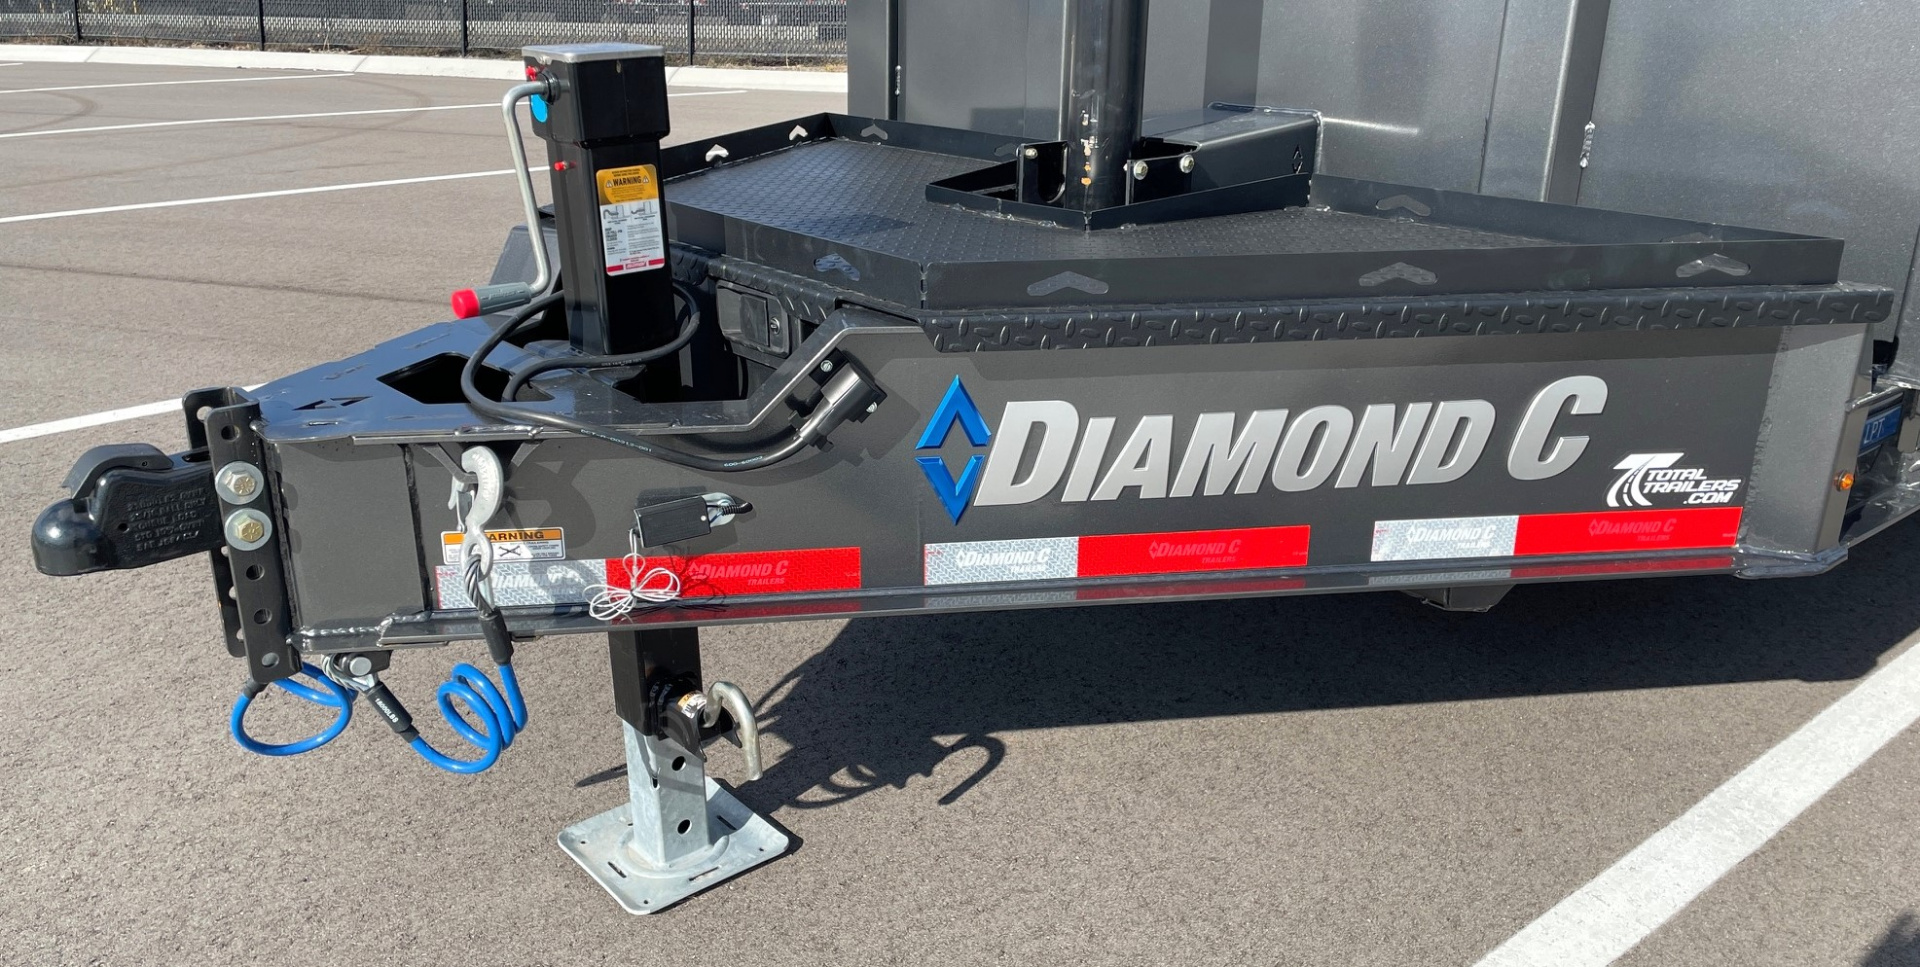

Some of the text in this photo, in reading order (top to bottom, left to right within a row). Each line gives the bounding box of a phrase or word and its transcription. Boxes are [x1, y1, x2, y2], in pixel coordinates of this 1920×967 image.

[612, 175, 642, 186] WARNING
[973, 375, 1608, 506] DIAMOND C
[1647, 468, 1707, 481] TOTAL
[1643, 479, 1741, 494] TRAILERS
[1683, 491, 1734, 504] .COM
[1415, 524, 1497, 541] DIAMOND C
[1594, 518, 1677, 535] DIAMOND C
[485, 531, 545, 541] ARNING
[1157, 539, 1242, 557] DIAMOND C
[963, 548, 1052, 566] DIAMOND C
[692, 560, 789, 580] DIAMOND C
[747, 577, 785, 586] TRAILERS
[374, 697, 398, 723] 18000LBS
